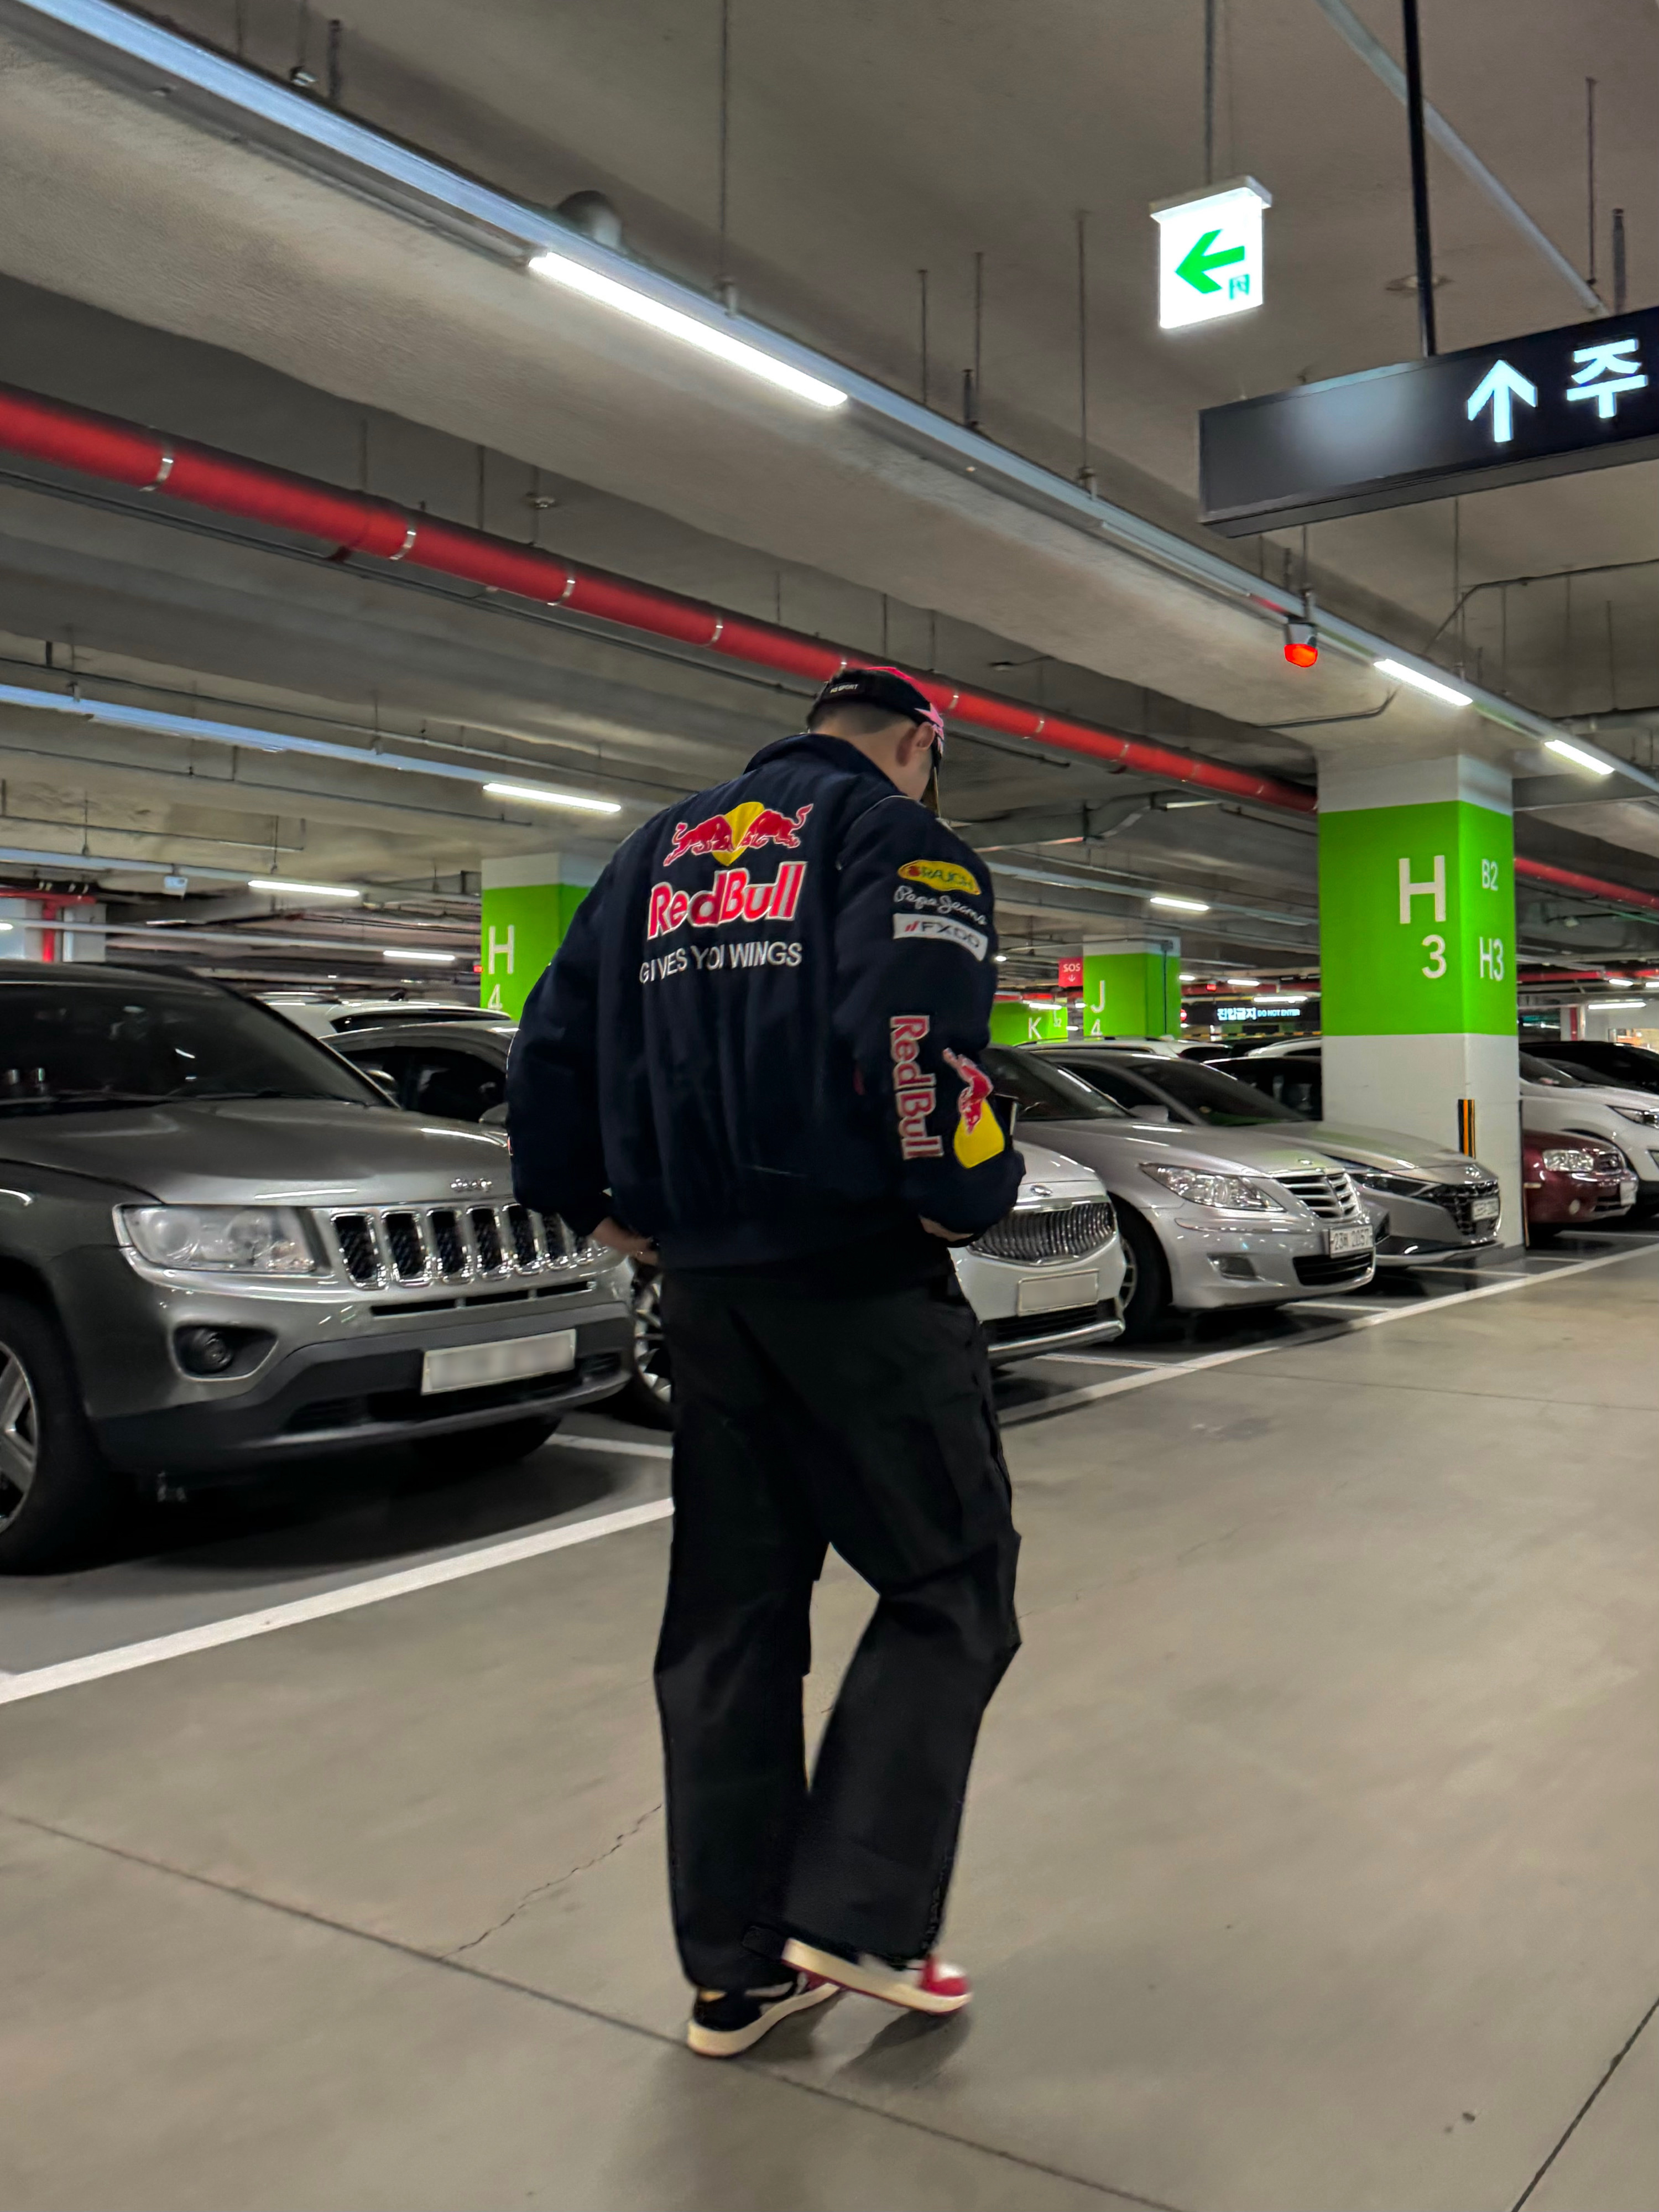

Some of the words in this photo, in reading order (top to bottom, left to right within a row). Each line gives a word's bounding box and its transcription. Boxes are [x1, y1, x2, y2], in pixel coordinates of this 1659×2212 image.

[1566, 339, 1647, 419] 주
[1399, 855, 1446, 924] H
[1481, 858, 1499, 891] B2
[488, 924, 514, 975] H
[639, 948, 688, 984] GIVES
[728, 940, 802, 968] WINGS
[1063, 963, 1081, 972] SOS
[1422, 934, 1447, 979] 3
[1479, 936, 1504, 981] H3
[488, 983, 503, 1010] 4
[1091, 980, 1105, 1013] J
[1028, 1017, 1042, 1039] K
[1091, 1018, 1103, 1035] 4
